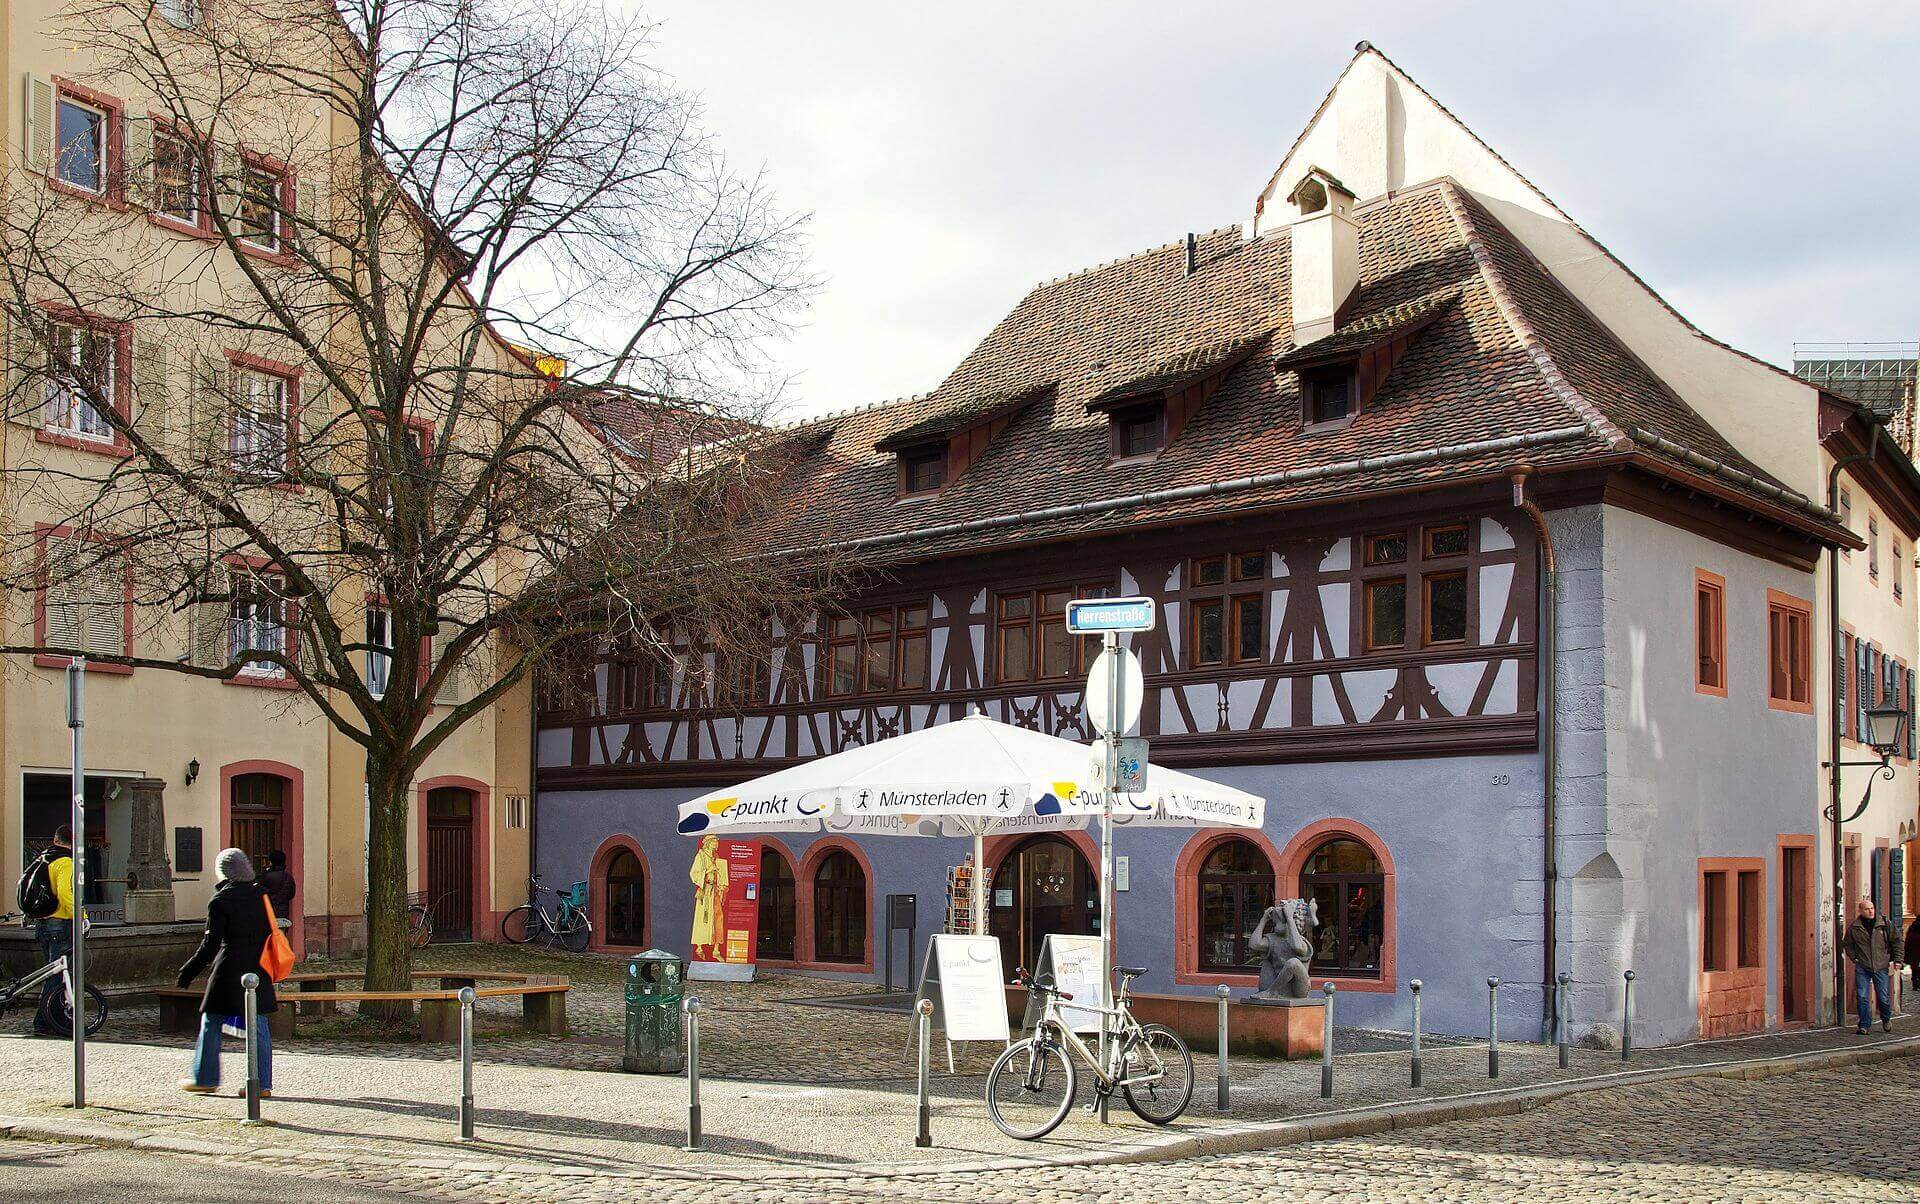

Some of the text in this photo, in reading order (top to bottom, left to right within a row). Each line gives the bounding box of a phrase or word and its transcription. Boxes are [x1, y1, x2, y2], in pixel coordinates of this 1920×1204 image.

[1077, 606, 1145, 624] Herrenstraße
[1491, 774, 1510, 786] 30
[721, 794, 788, 820] c-punkt
[879, 790, 987, 807] Münsterladen
[1068, 790, 1122, 811] c-put
[1183, 795, 1242, 817] Münsterladen
[87, 908, 124, 921] mme
